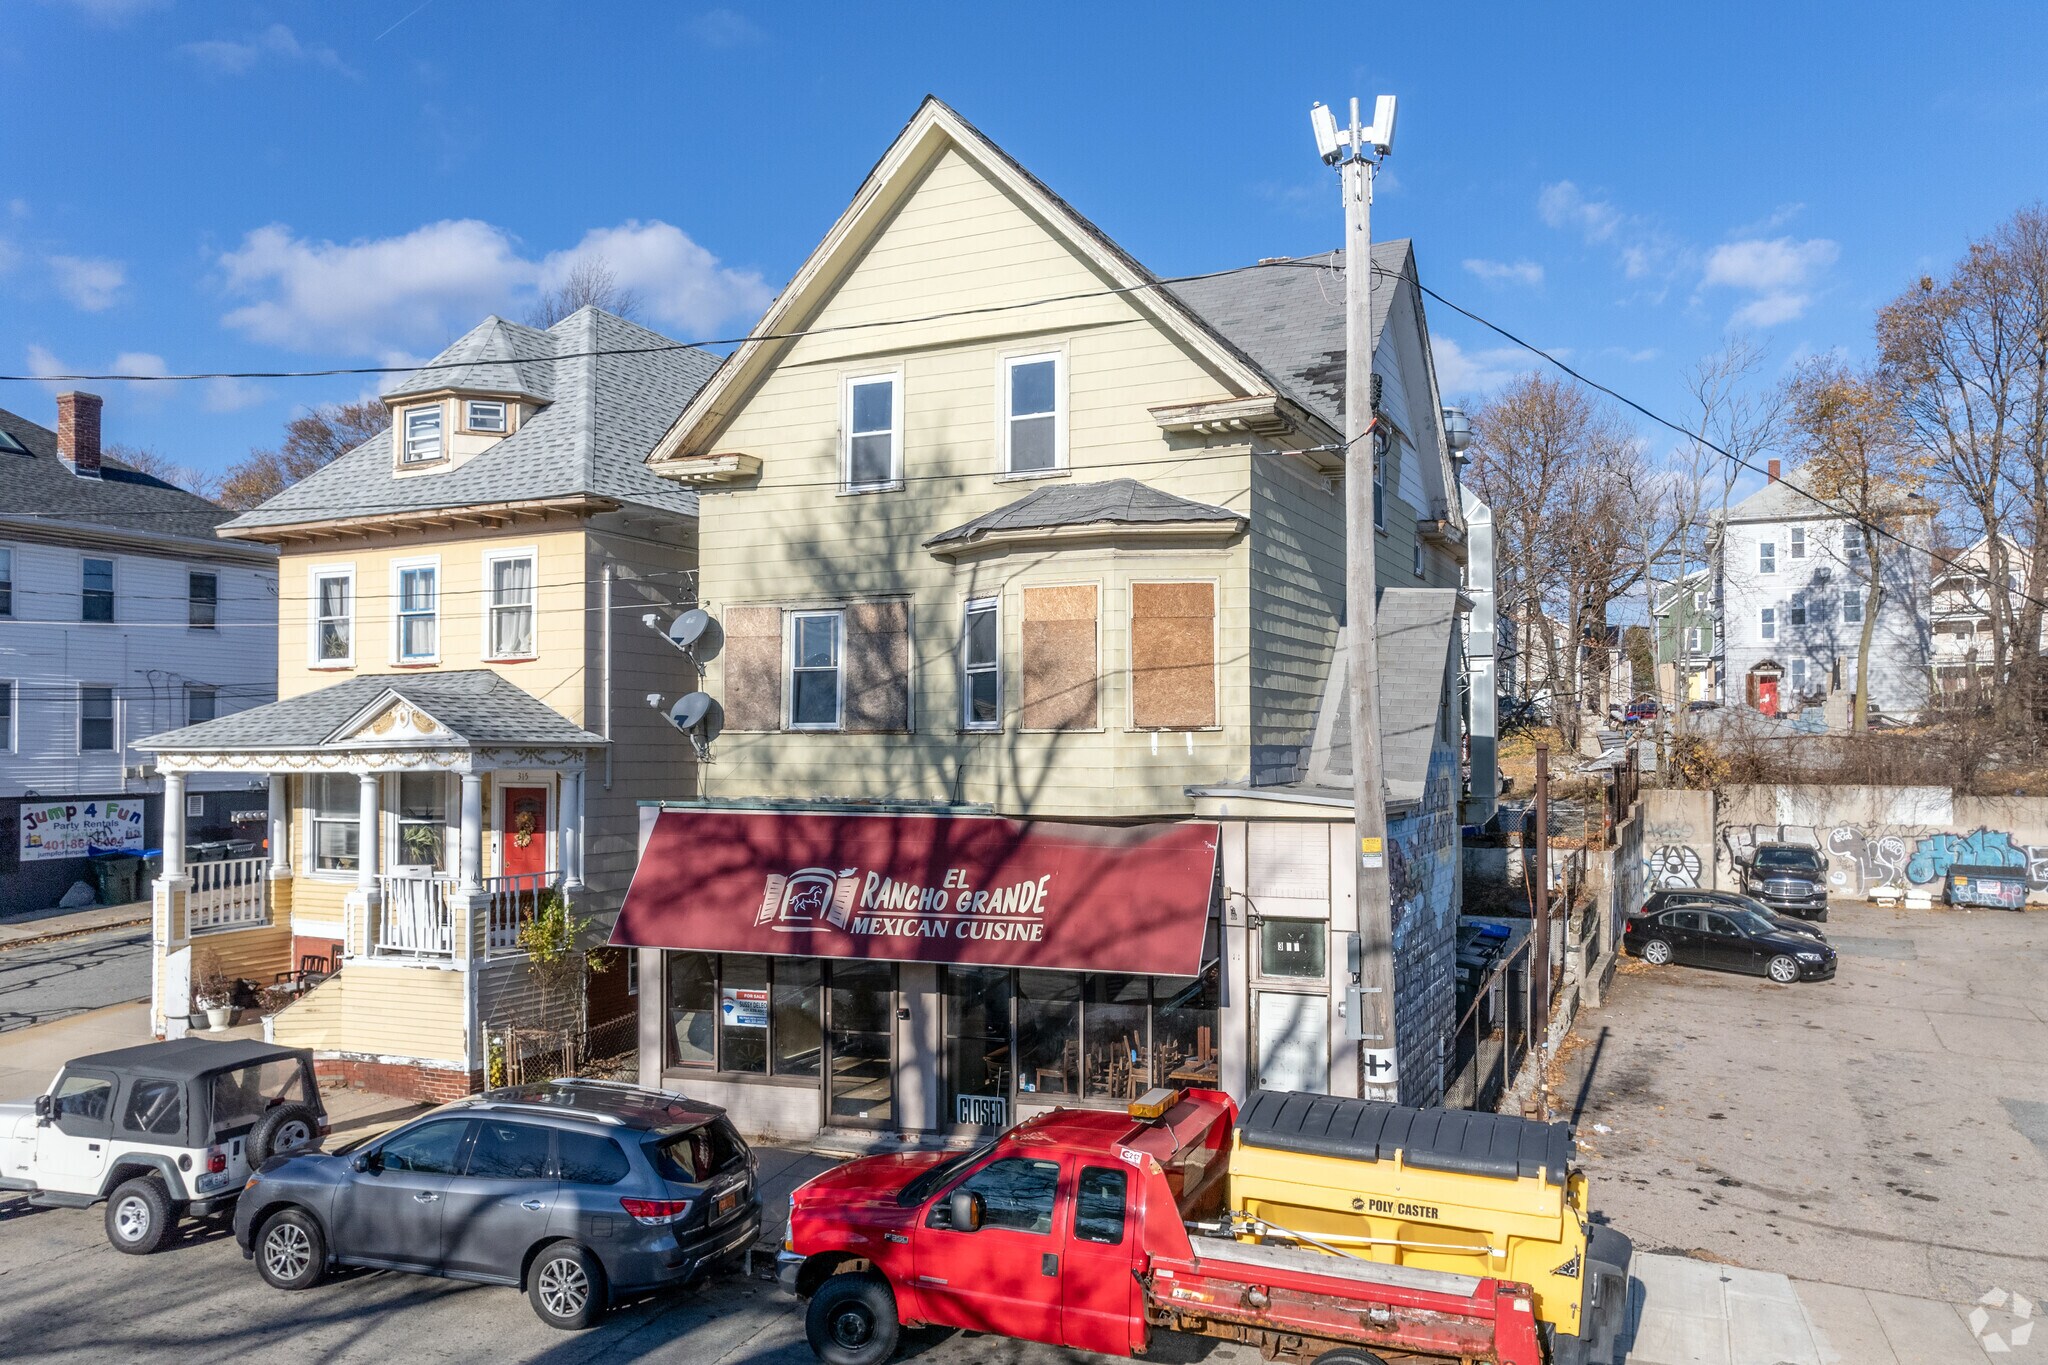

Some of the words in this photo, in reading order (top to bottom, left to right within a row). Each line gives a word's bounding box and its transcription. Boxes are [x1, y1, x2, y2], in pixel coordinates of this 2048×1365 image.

[518, 772, 528, 780] 315
[23, 805, 77, 830] Jump
[84, 803, 97, 818] 4
[106, 803, 141, 824] Fun
[53, 822, 80, 831] Party
[84, 820, 119, 829] Rentals
[943, 868, 969, 889] EL
[860, 870, 948, 911] RANCHO
[955, 874, 1050, 914] GRANDE
[850, 917, 949, 938] MEXICAN
[955, 920, 1044, 942] CUISINE
[960, 1097, 1002, 1126] CLOSED
[1368, 1198, 1393, 1213] POLY
[1397, 1203, 1438, 1219] CASTER
